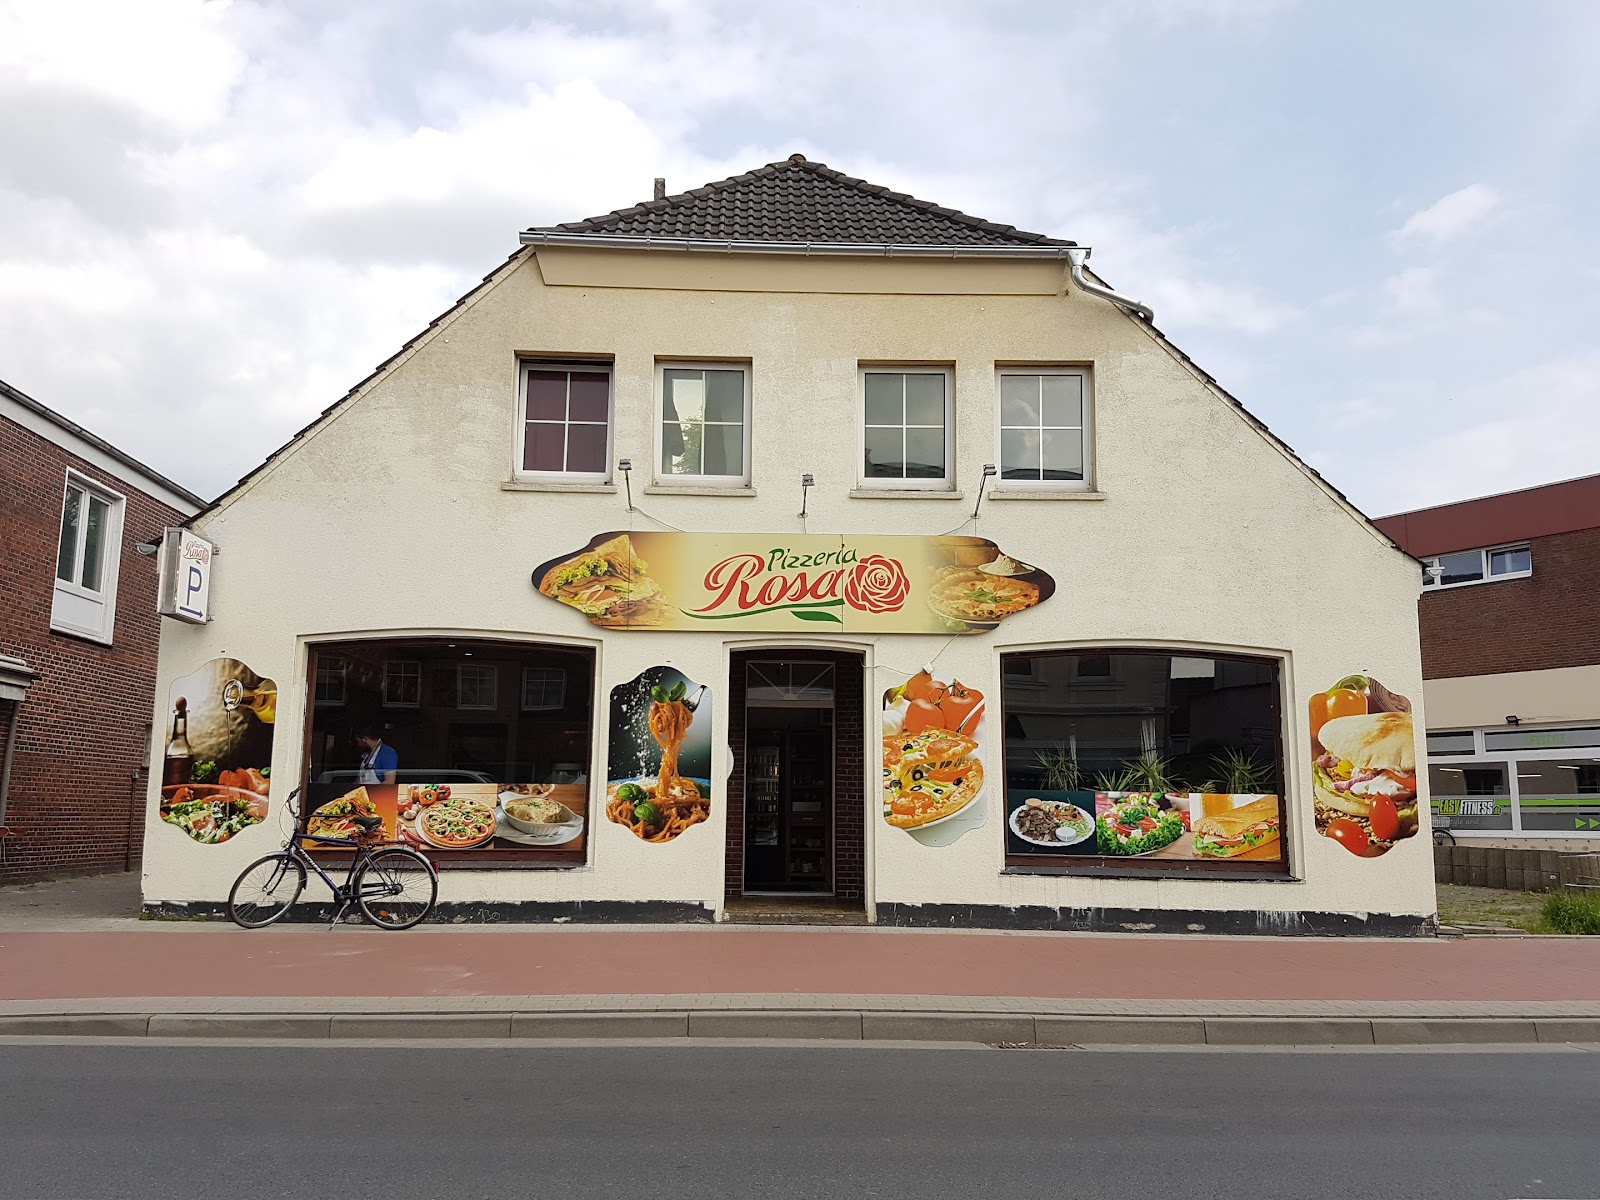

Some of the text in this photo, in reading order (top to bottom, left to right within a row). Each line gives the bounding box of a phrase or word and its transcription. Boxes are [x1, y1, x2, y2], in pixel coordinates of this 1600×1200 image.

[185, 541, 203, 557] Rosa
[767, 546, 859, 572] Pizzeria
[187, 565, 202, 606] P
[689, 553, 846, 612] Rosa
